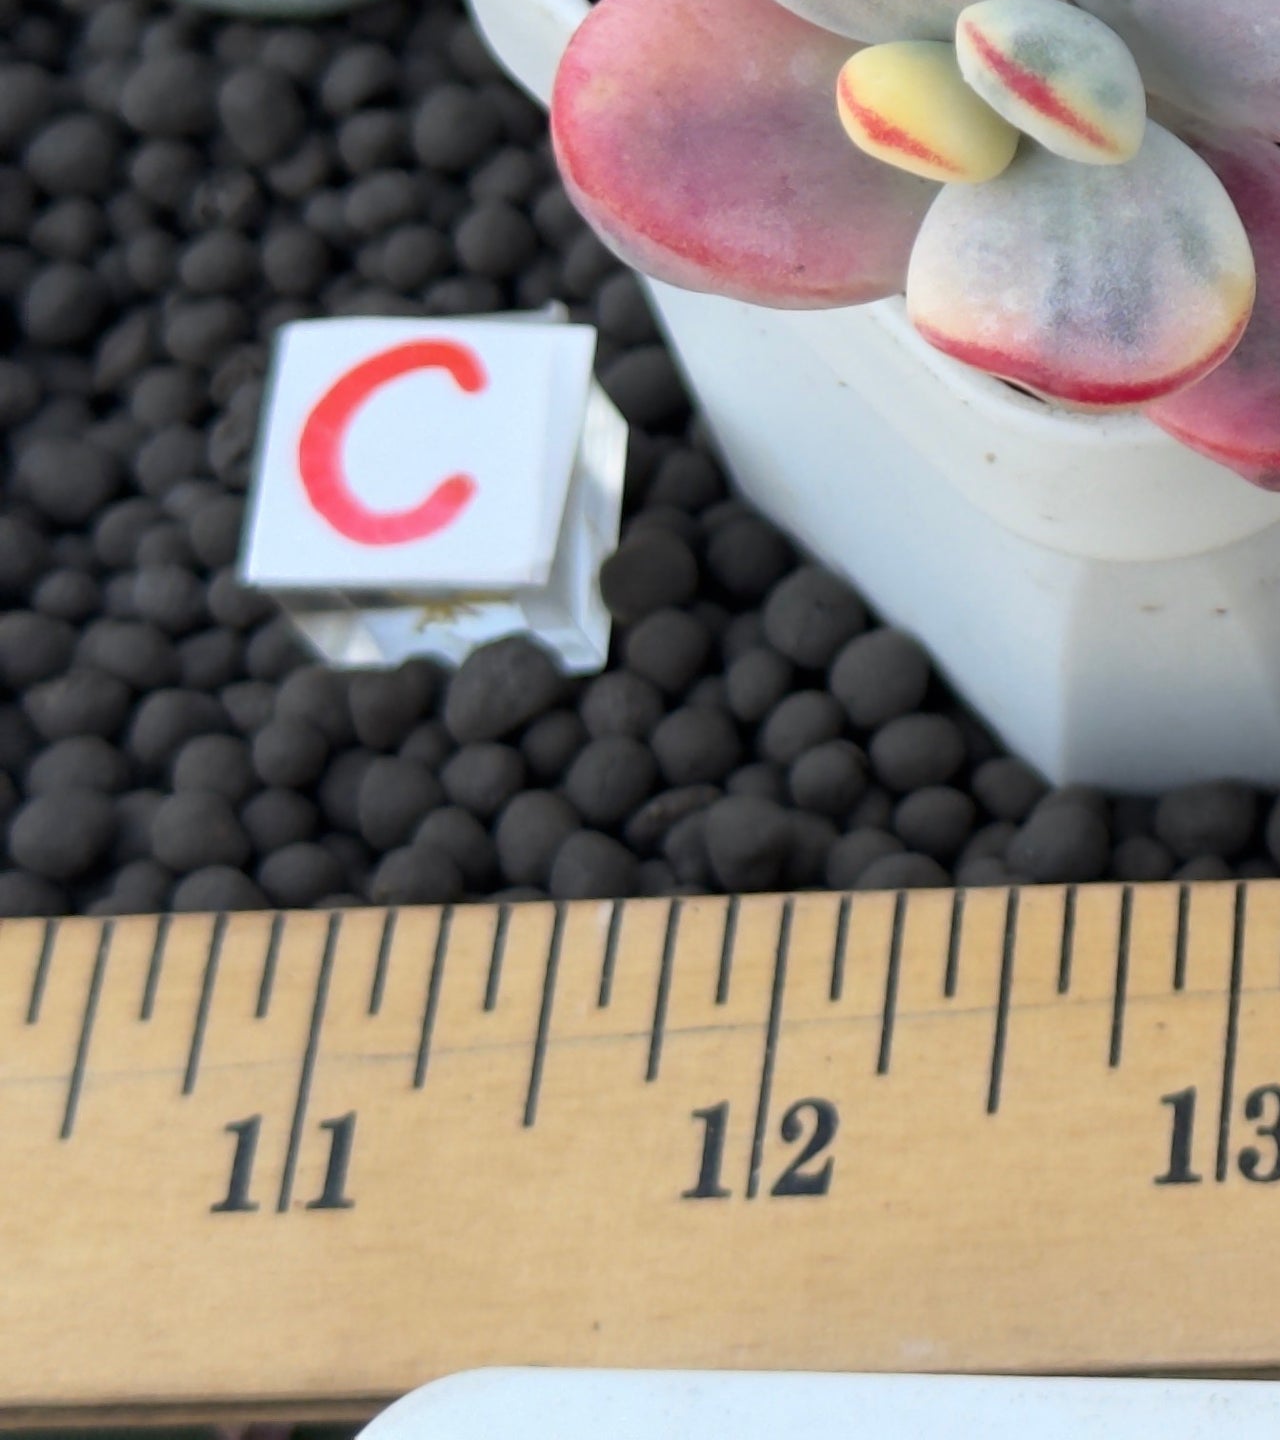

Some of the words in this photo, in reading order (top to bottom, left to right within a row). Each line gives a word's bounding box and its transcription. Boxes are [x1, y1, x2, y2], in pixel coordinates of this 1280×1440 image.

[297, 338, 488, 548] C
[211, 1110, 356, 1213] 11
[681, 1097, 840, 1200] 12
